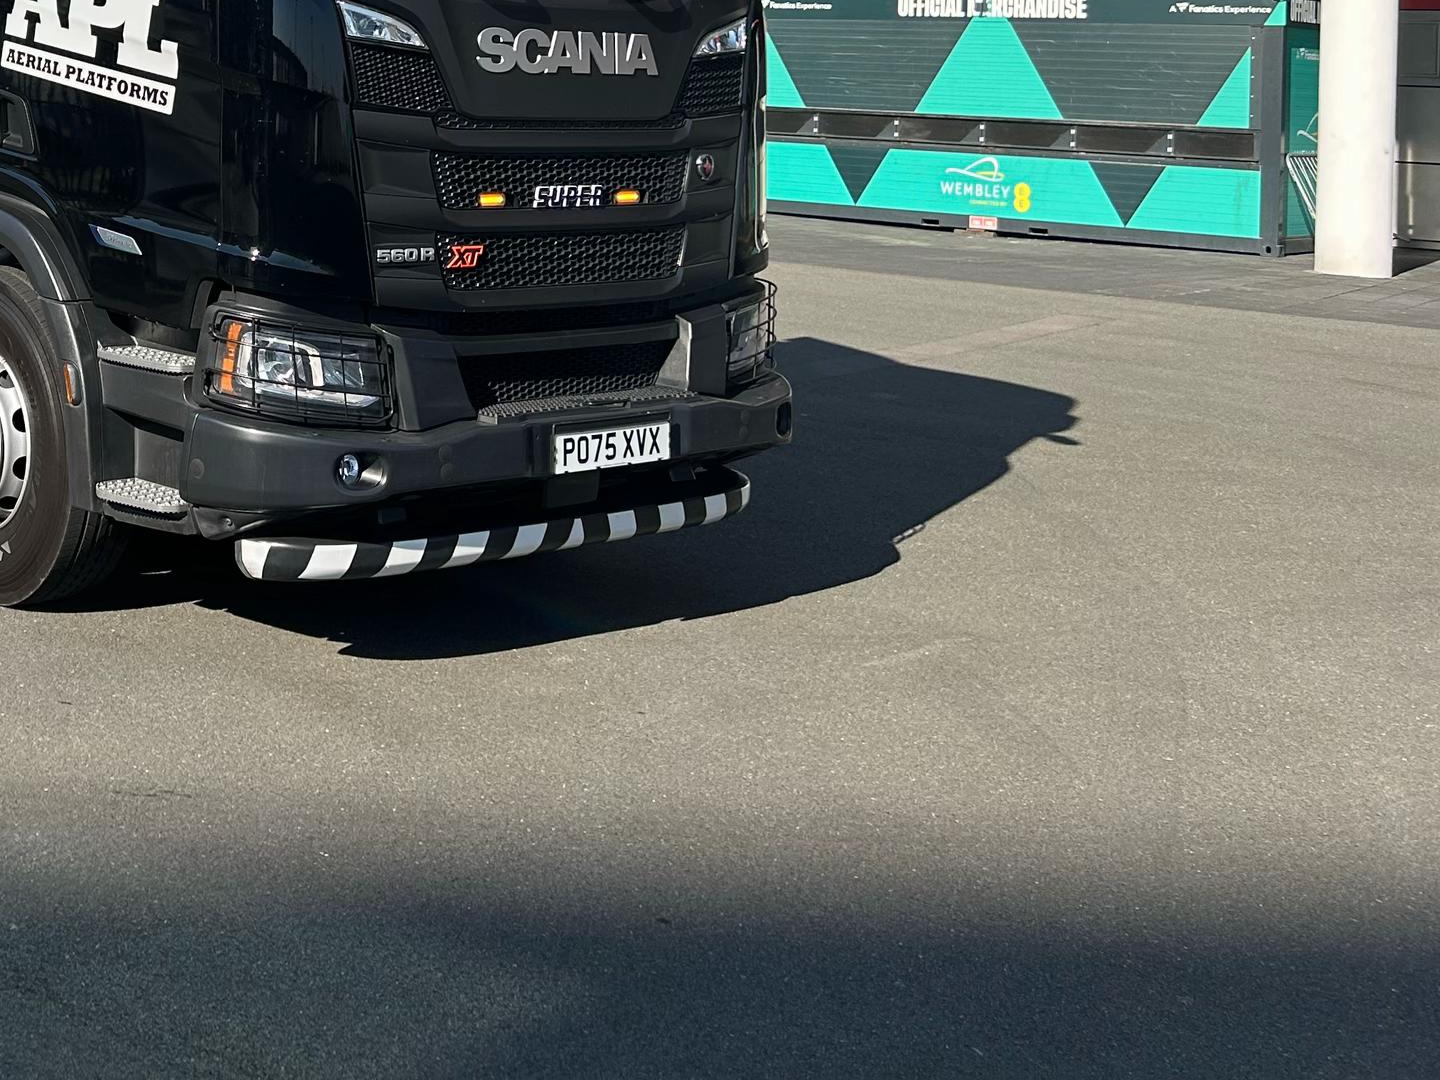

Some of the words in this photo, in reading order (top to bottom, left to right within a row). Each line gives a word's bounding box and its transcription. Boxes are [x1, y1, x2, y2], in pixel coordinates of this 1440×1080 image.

[1168, 5, 1177, 14] A
[1189, 4, 1224, 14] Fanatics
[1224, 4, 1272, 15] Experience
[476, 27, 659, 76] SCANIA
[6, 48, 61, 77] AERIAL
[64, 64, 169, 107] PLATFORMS
[532, 184, 604, 209] SUPER
[940, 181, 1011, 199] WEMBLEY
[376, 247, 418, 265] 560
[446, 245, 484, 269] XT
[563, 432, 617, 466] PO75
[622, 427, 661, 458] XVX
